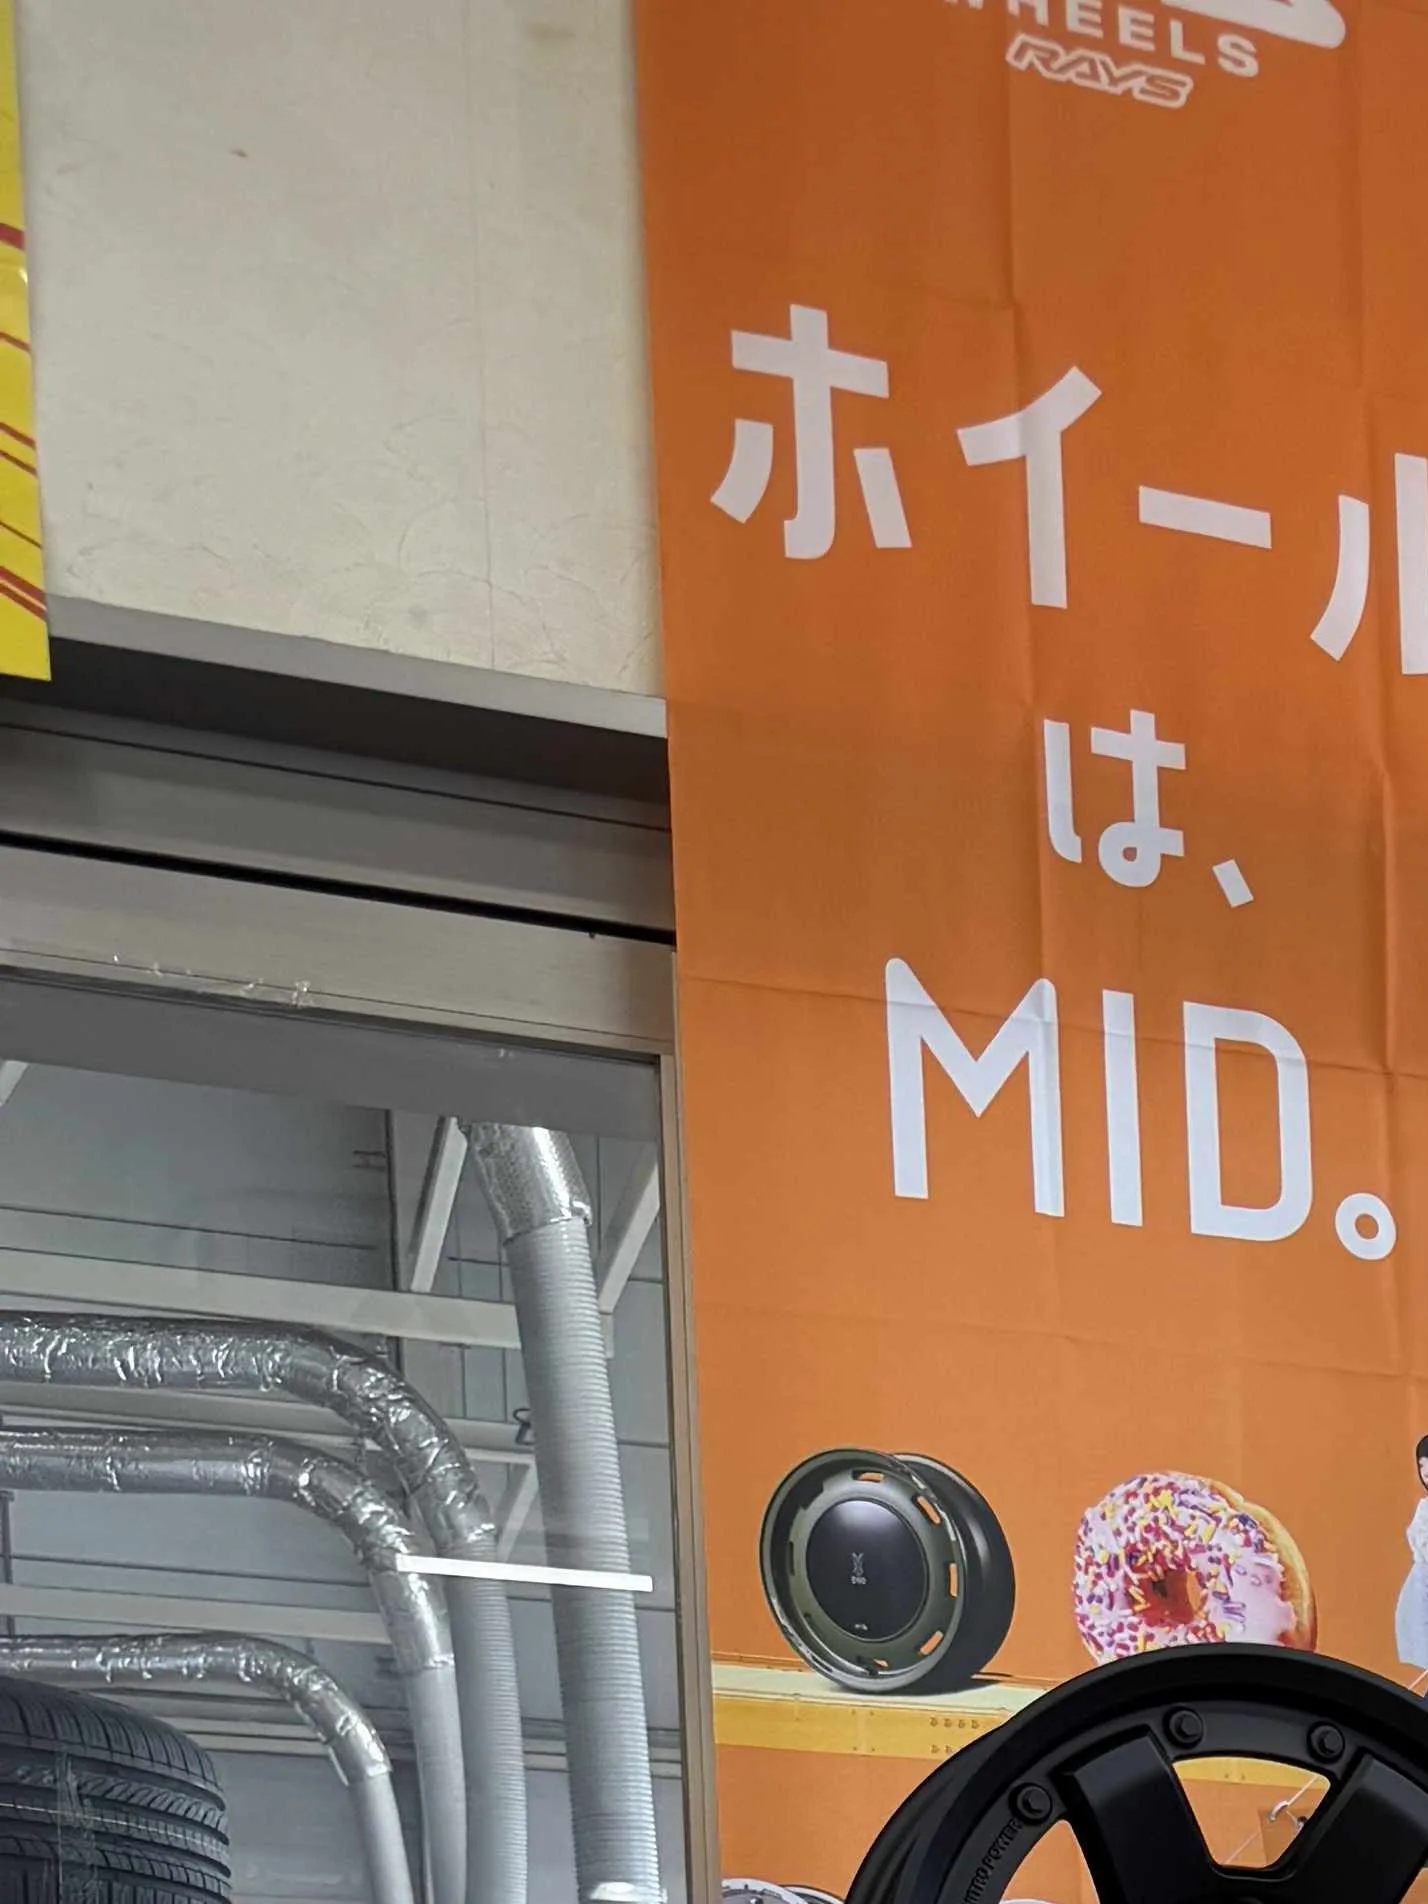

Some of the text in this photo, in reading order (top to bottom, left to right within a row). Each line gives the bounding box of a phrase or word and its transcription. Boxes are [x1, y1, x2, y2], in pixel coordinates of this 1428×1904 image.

[945, 0, 1259, 77] HEELS
[1004, 33, 1193, 108] RAYS
[1043, 709, 1253, 908] は、
[885, 957, 1396, 1260] MID。
